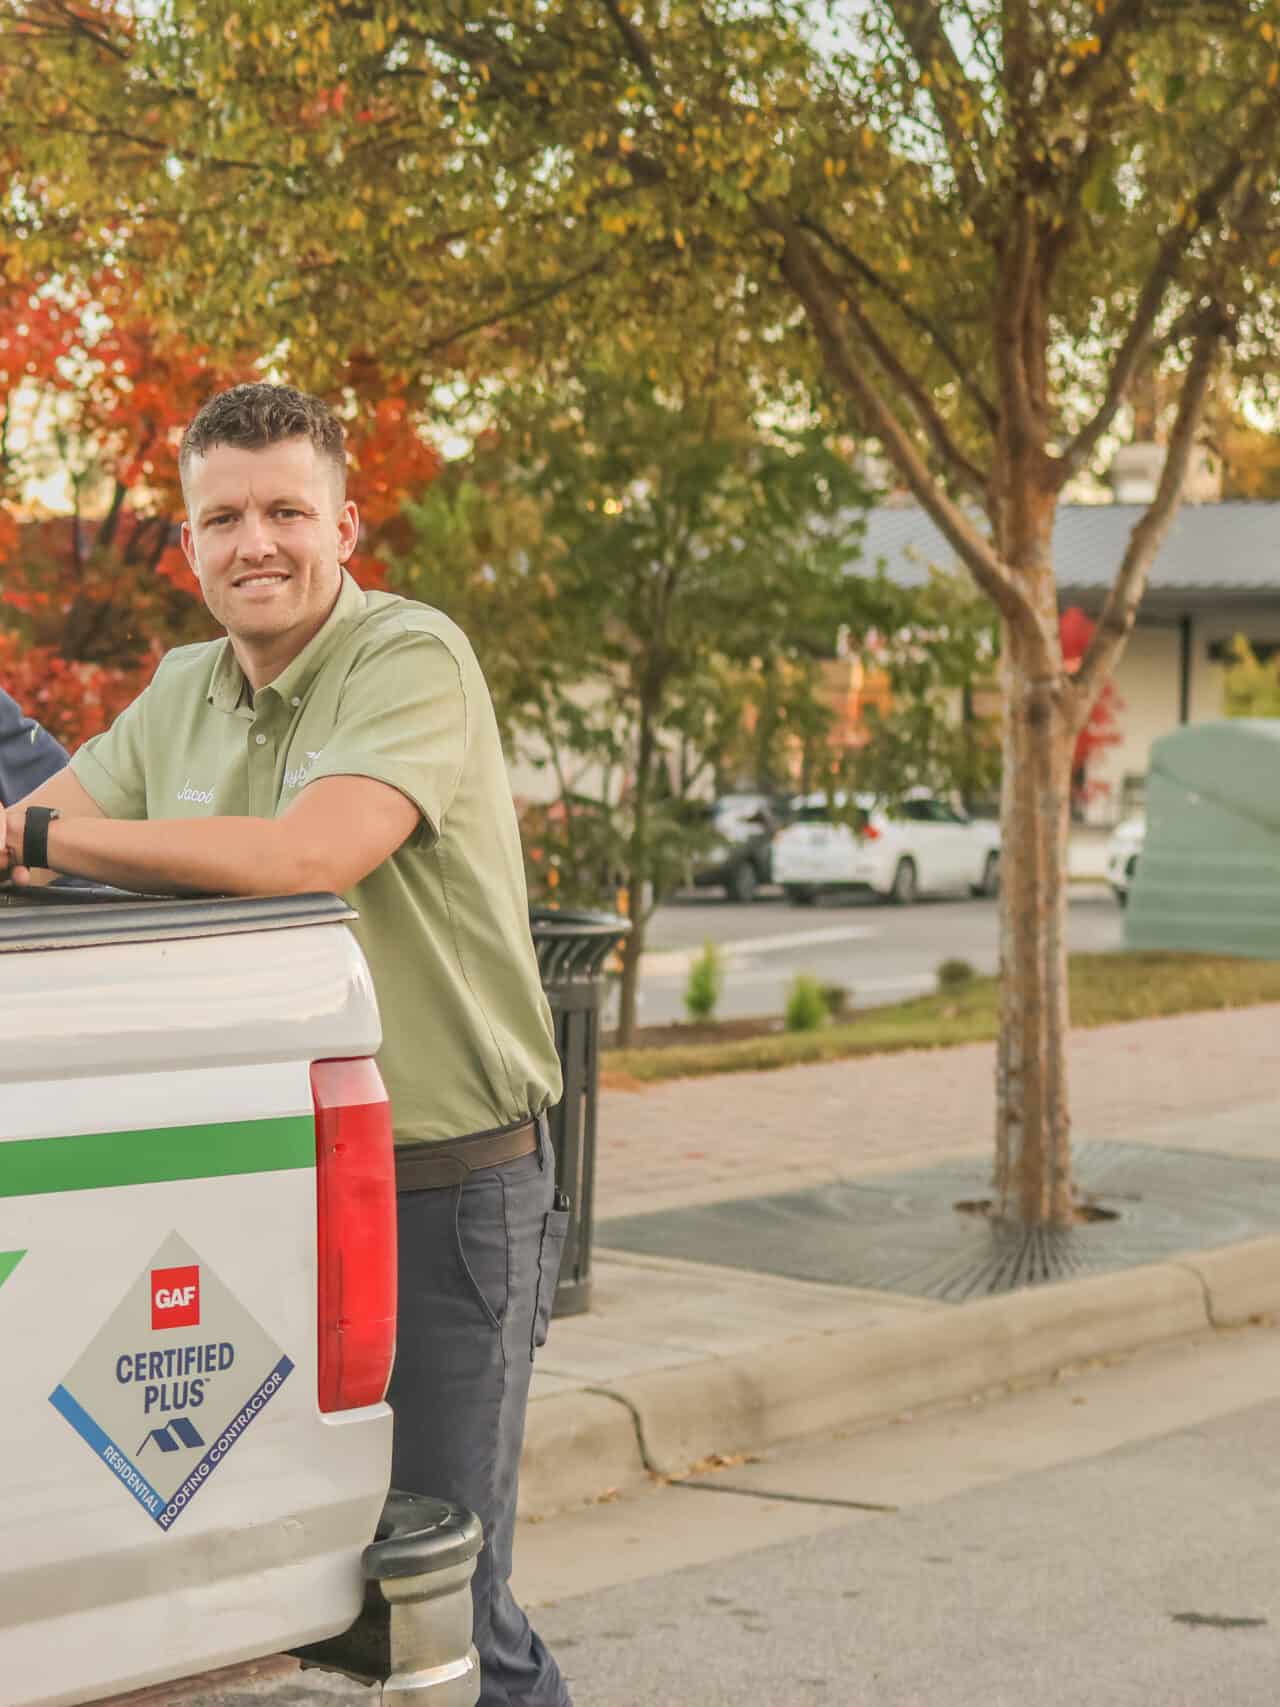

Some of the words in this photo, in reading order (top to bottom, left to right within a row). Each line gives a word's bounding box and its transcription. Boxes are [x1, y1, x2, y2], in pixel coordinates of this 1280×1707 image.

[177, 777, 215, 804] Jacob
[155, 1286, 196, 1309] GAF
[115, 1342, 235, 1384] CERTIFIED
[144, 1378, 206, 1414] PLUS
[159, 1463, 210, 1527] ROOFING
[210, 1371, 283, 1461] CONTRACTOR
[103, 1446, 160, 1513] RESIDENTIAL
